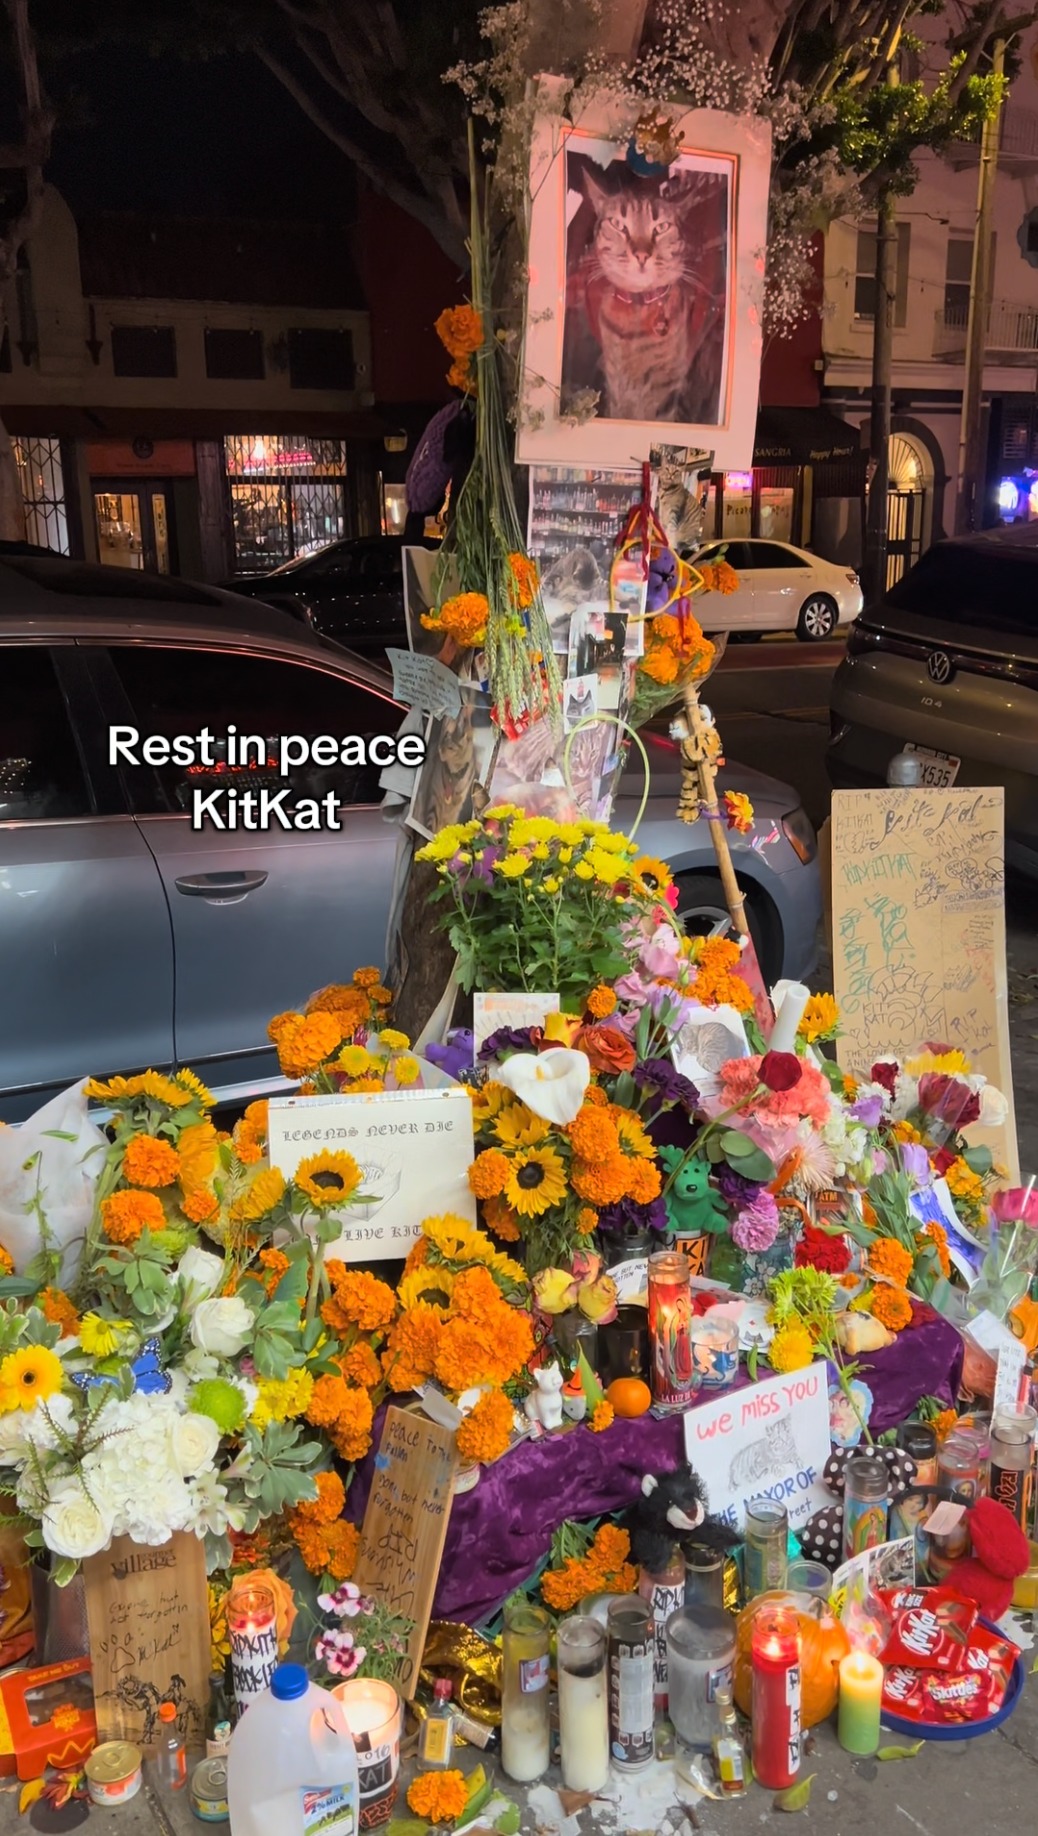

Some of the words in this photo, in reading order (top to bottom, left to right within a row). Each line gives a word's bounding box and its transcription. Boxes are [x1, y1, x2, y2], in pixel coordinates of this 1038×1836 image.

[754, 448, 792, 457] SANGRIA
[919, 762, 952, 788] X535
[862, 1002, 888, 1014] KIT
[864, 1013, 889, 1028] KAT
[845, 1050, 861, 1058] THE
[283, 1127, 359, 1142] LEGENDS
[366, 1123, 419, 1138] NEVER
[425, 1120, 454, 1133] DIE
[344, 1227, 384, 1241] LIVE
[782, 1376, 819, 1407] YOU
[796, 1466, 818, 1491] OF
[788, 1497, 813, 1519] reet
[901, 1608, 940, 1656] KitKat
[884, 1666, 917, 1701] KitKa
[929, 1682, 979, 1701] Skittles
